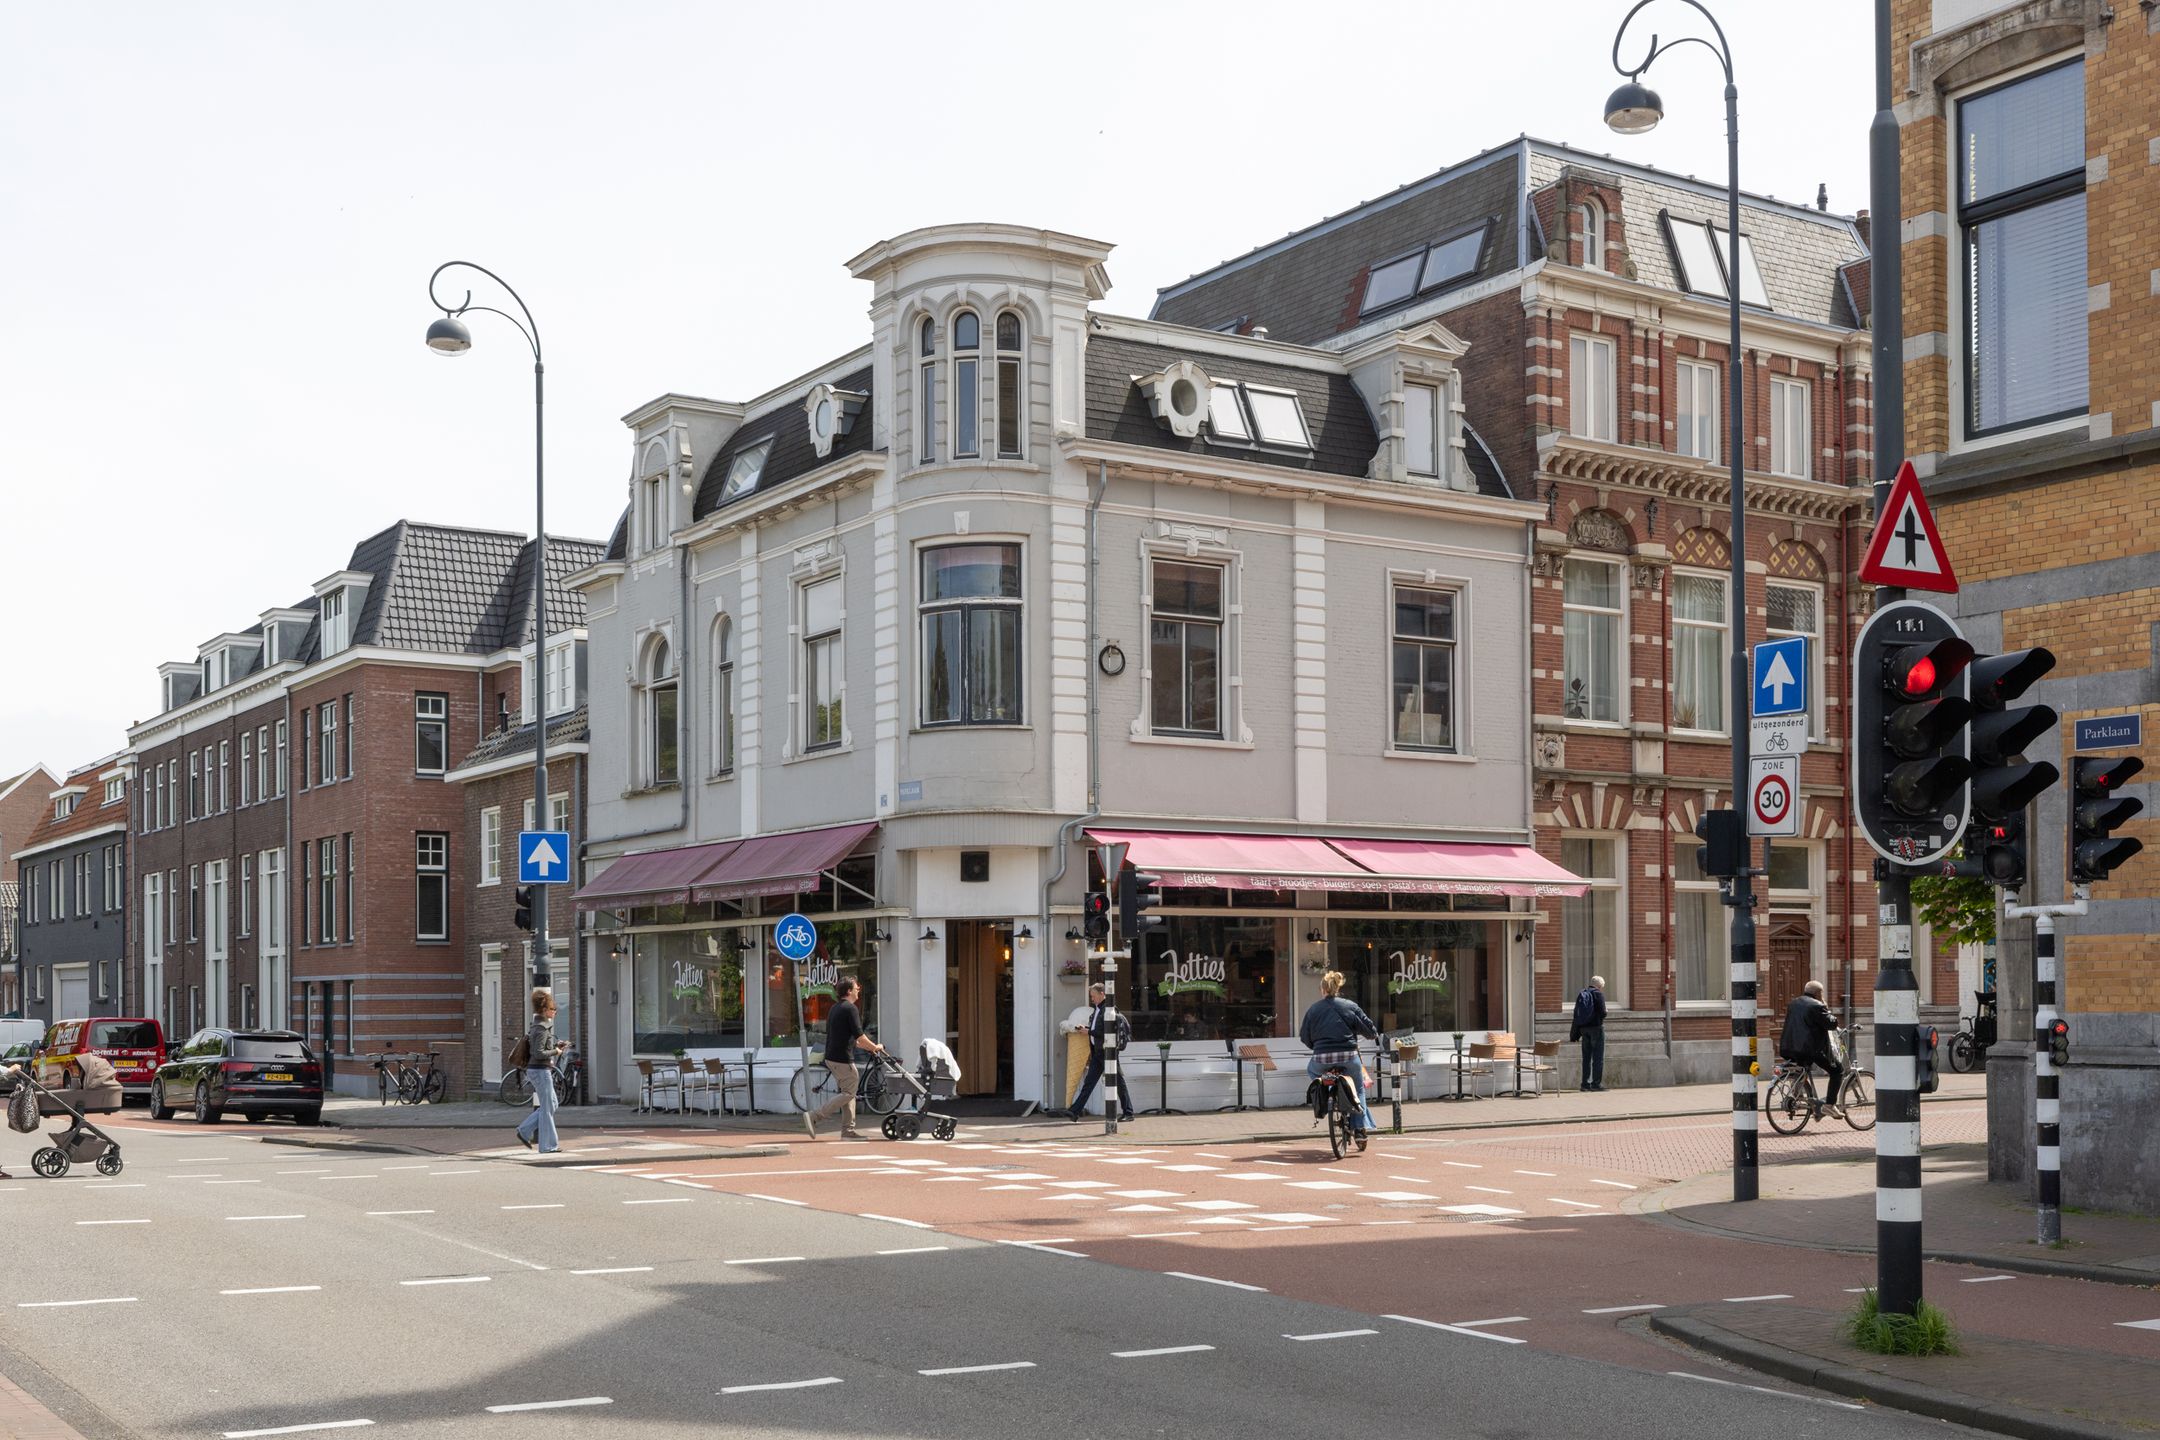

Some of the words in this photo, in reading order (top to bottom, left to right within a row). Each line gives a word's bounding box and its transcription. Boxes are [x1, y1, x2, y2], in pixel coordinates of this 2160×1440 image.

[1582, 523, 1609, 538] ANNO
[1896, 618, 1924, 632] 11.1
[1753, 718, 1804, 730] uitgezonderd
[2085, 726, 2131, 739] Parklaan
[1762, 761, 1784, 770] ZONE
[1761, 790, 1783, 809] 30
[1183, 873, 1217, 886] jetties
[1279, 877, 1317, 888] broodjes
[1323, 878, 1355, 889] burgers
[1361, 882, 1381, 890] soep
[1388, 881, 1416, 891] pasta's
[1534, 884, 1563, 896] jetties
[803, 957, 839, 998] Jetties
[1160, 949, 1226, 996] Jetties
[1389, 951, 1447, 994] Jetties
[673, 960, 703, 1000] Jetties
